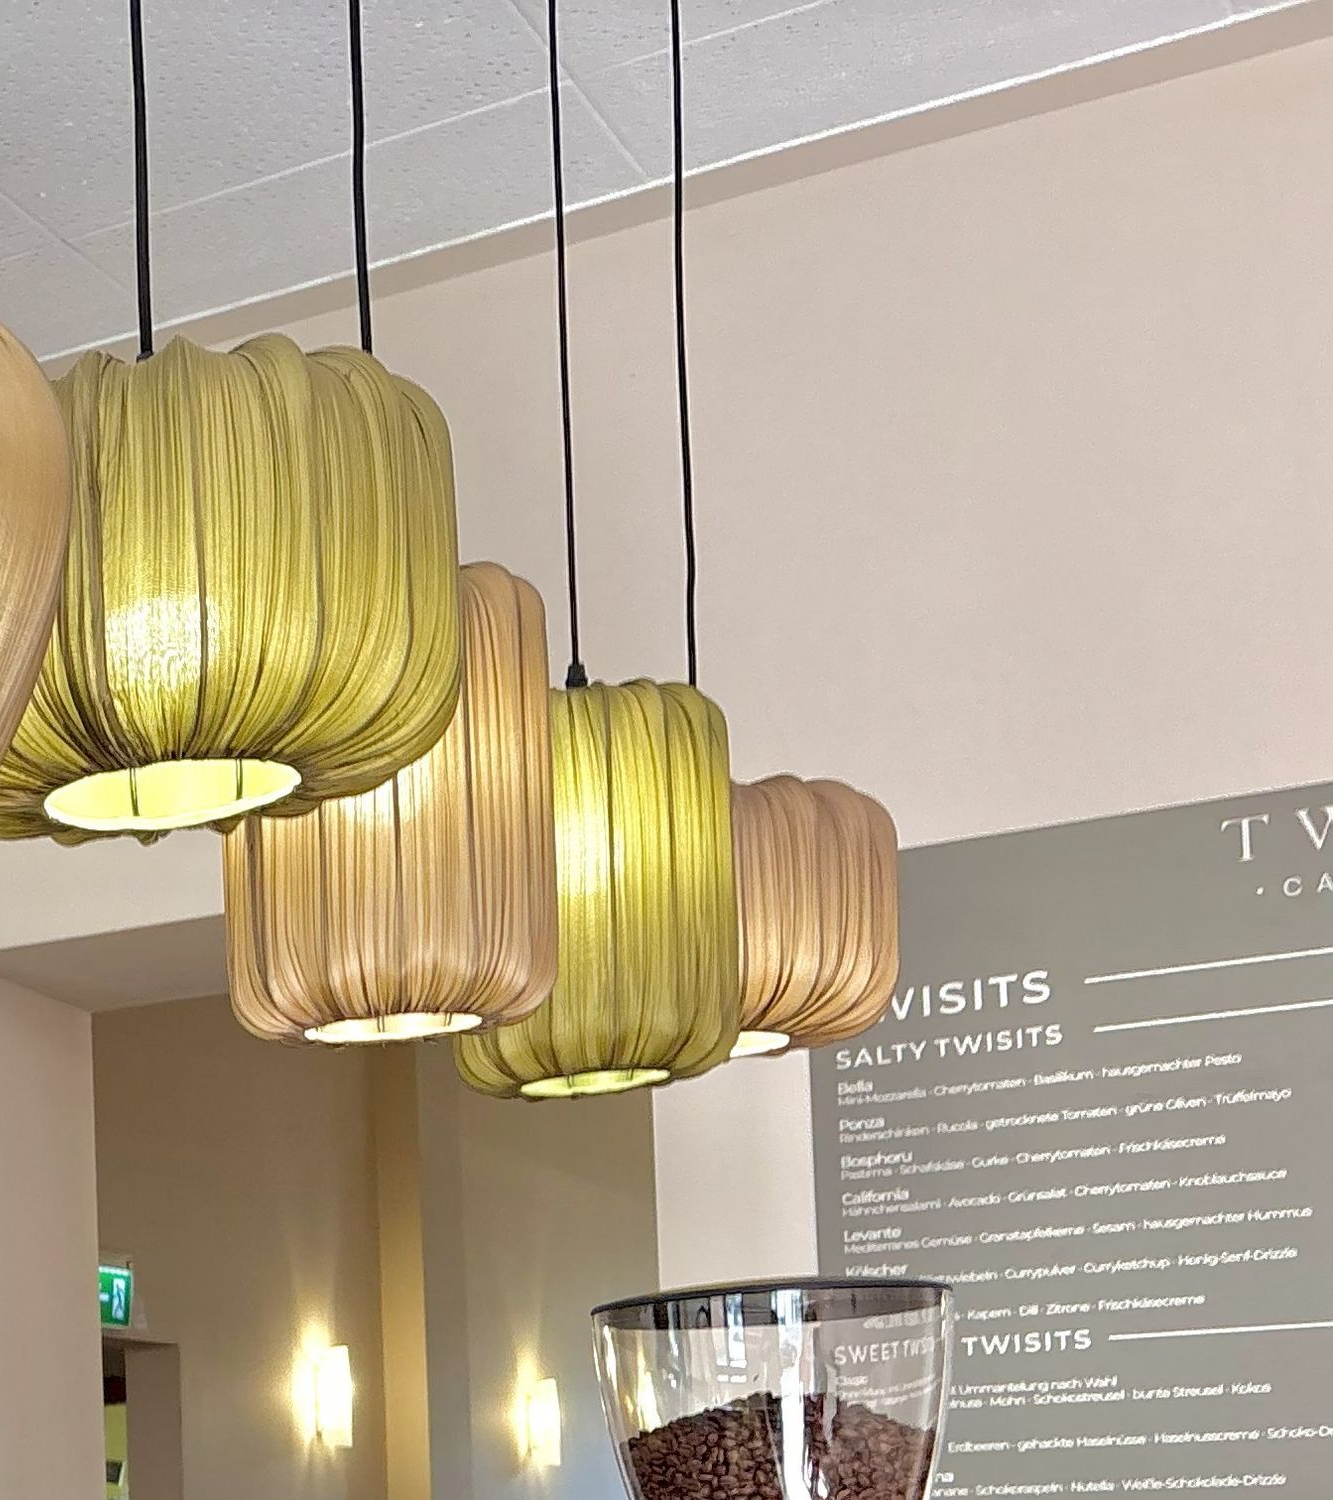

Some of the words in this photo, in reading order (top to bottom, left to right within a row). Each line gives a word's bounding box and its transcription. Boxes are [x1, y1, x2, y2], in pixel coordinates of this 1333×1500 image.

[879, 969, 1052, 1023] WISITS
[835, 1039, 927, 1070] SALTY
[933, 1023, 1063, 1058] TWISITS
[1033, 1069, 1094, 1086] Basilikum
[1102, 1056, 1203, 1079] hausgemachter
[1205, 1053, 1242, 1068] Pesto
[985, 1113, 1059, 1131] getrocknete
[1062, 1105, 1117, 1121] Tomaten
[1125, 1100, 1163, 1117] grüne
[1166, 1095, 1207, 1111] Oliven
[971, 1155, 1009, 1169] Gurke
[1016, 1145, 1111, 1165] Cherrytomaten
[841, 1187, 910, 1206] California
[948, 1193, 1000, 1209] Avocado
[1074, 1177, 1170, 1198] Cherrytomaten
[1092, 1220, 1135, 1235] Sesam
[1143, 1210, 1245, 1231] hausgemachter
[1248, 1206, 1313, 1222] Hummus
[843, 1226, 903, 1243] Levante
[1083, 1256, 1171, 1275] Curryketchup
[834, 1340, 900, 1365] SWEET
[960, 1328, 1092, 1356] TWISITS
[1051, 1377, 1082, 1391] nach
[1084, 1375, 1118, 1389] Wahl
[989, 1395, 1026, 1408] Mohn
[1017, 1436, 1074, 1453] gehackte
[1070, 1479, 1116, 1493] Nutella
